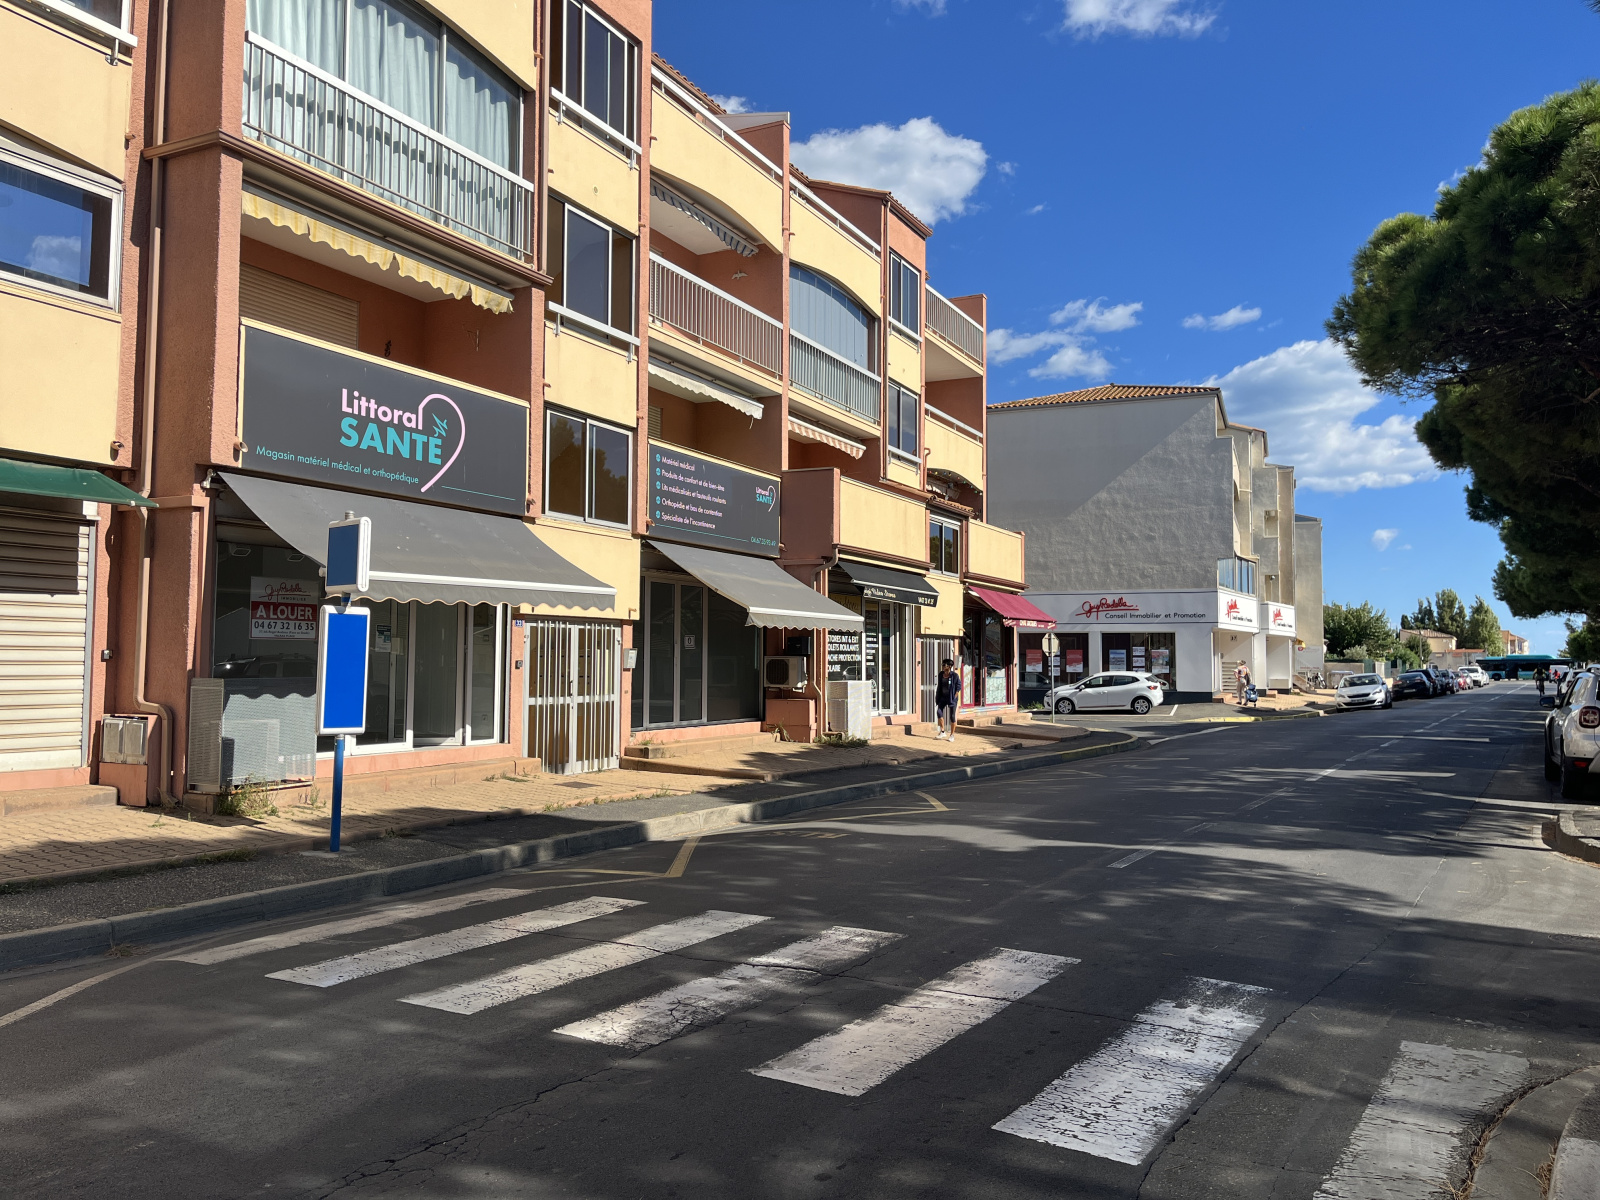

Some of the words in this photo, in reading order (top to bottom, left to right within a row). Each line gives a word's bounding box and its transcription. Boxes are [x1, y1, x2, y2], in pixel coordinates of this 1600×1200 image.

[341, 388, 423, 430] Littoral
[256, 445, 295, 461] Magasin
[297, 455, 330, 468] matériel
[331, 460, 362, 473] médical
[371, 468, 419, 484] orthopédique
[661, 456, 679, 467] Matériel
[679, 461, 695, 471] médical
[661, 469, 678, 480] Produits
[678, 473, 684, 482] de
[684, 476, 698, 485] confort
[703, 480, 708, 488] de
[661, 497, 685, 509] Orthopédie
[698, 505, 703, 513] de
[661, 512, 683, 521] Spécialiste
[683, 516, 689, 524] de
[256, 604, 267, 618] A
[270, 604, 313, 620] LOUER
[254, 620, 265, 630] 04
[267, 621, 278, 630] 67
[280, 621, 291, 630] 32
[293, 622, 303, 631] 16
[304, 622, 315, 631] 35
[840, 643, 859, 652] ROULANTS
[838, 653, 861, 662] PROTECTION
